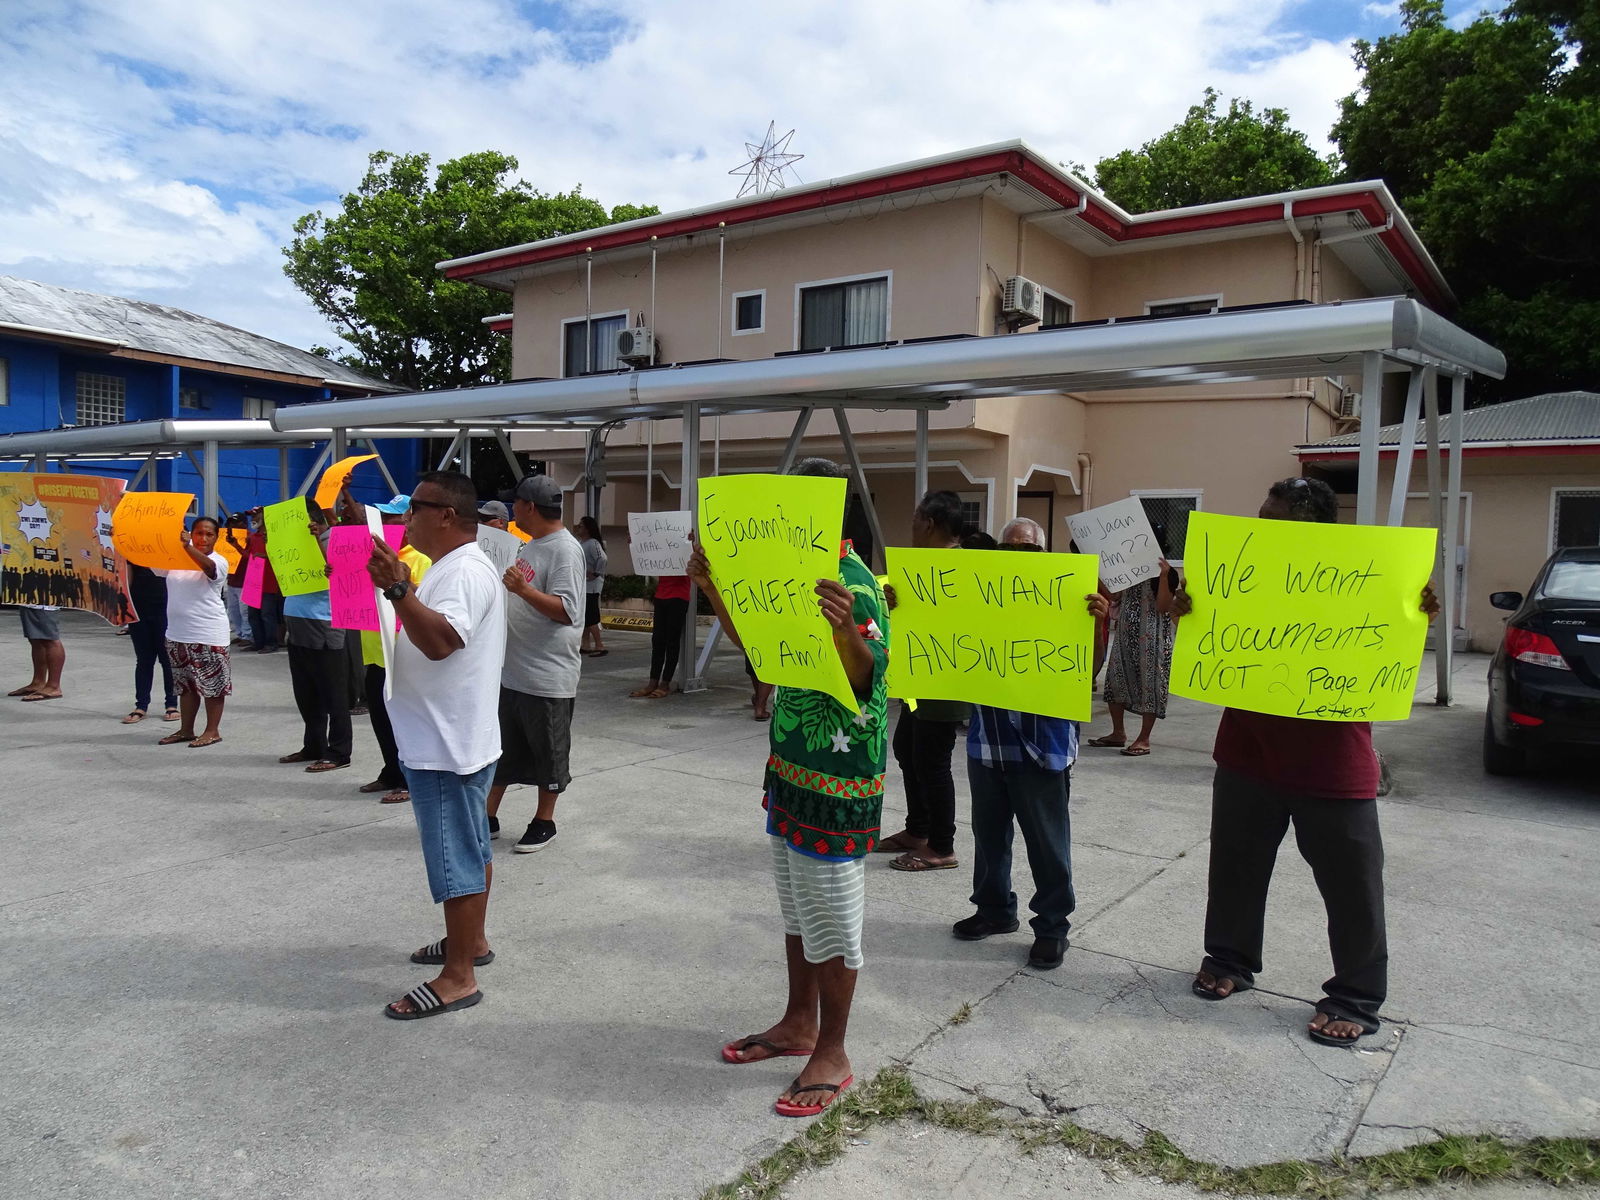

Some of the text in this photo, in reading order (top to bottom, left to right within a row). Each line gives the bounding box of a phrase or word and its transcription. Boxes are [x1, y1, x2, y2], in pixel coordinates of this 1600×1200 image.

[158, 499, 176, 518] Has
[337, 568, 363, 598] NOT
[1205, 532, 1385, 599] We want
[903, 566, 1075, 611] WE WANT
[610, 617, 653, 627] KBE CLERK
[906, 630, 1088, 682] ANSWERS!!
[1189, 659, 1261, 691] NOT
[1268, 662, 1295, 696] 2
[1307, 666, 1361, 706] Page
